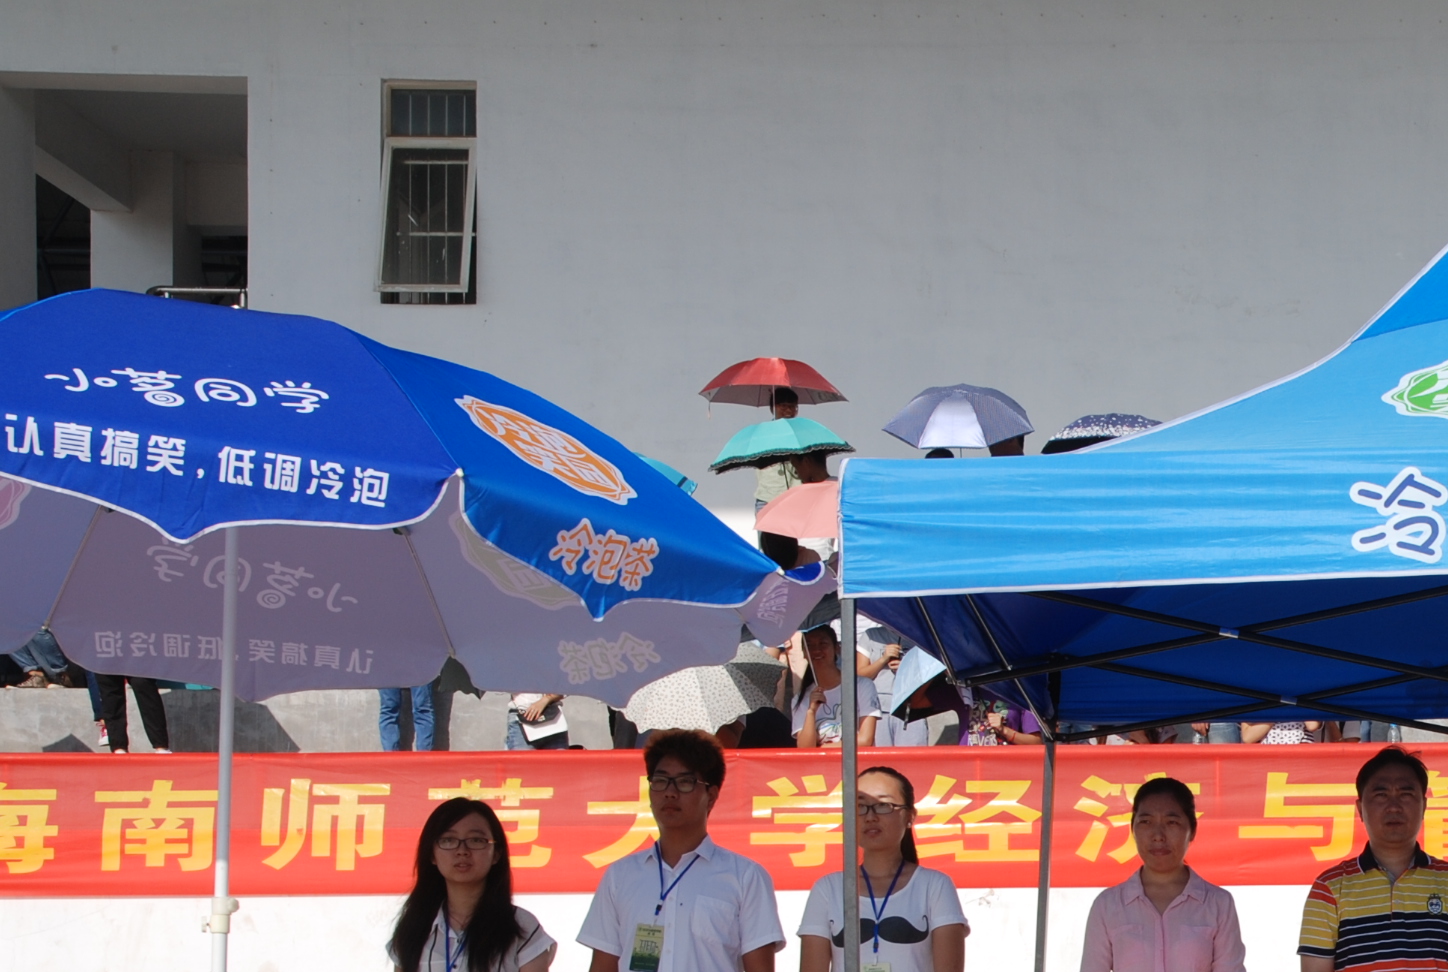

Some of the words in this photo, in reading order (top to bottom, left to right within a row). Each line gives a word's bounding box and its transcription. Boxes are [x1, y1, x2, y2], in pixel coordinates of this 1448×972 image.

[44, 367, 330, 413] 小茗同学
[552, 520, 657, 589] 冷泡茶
